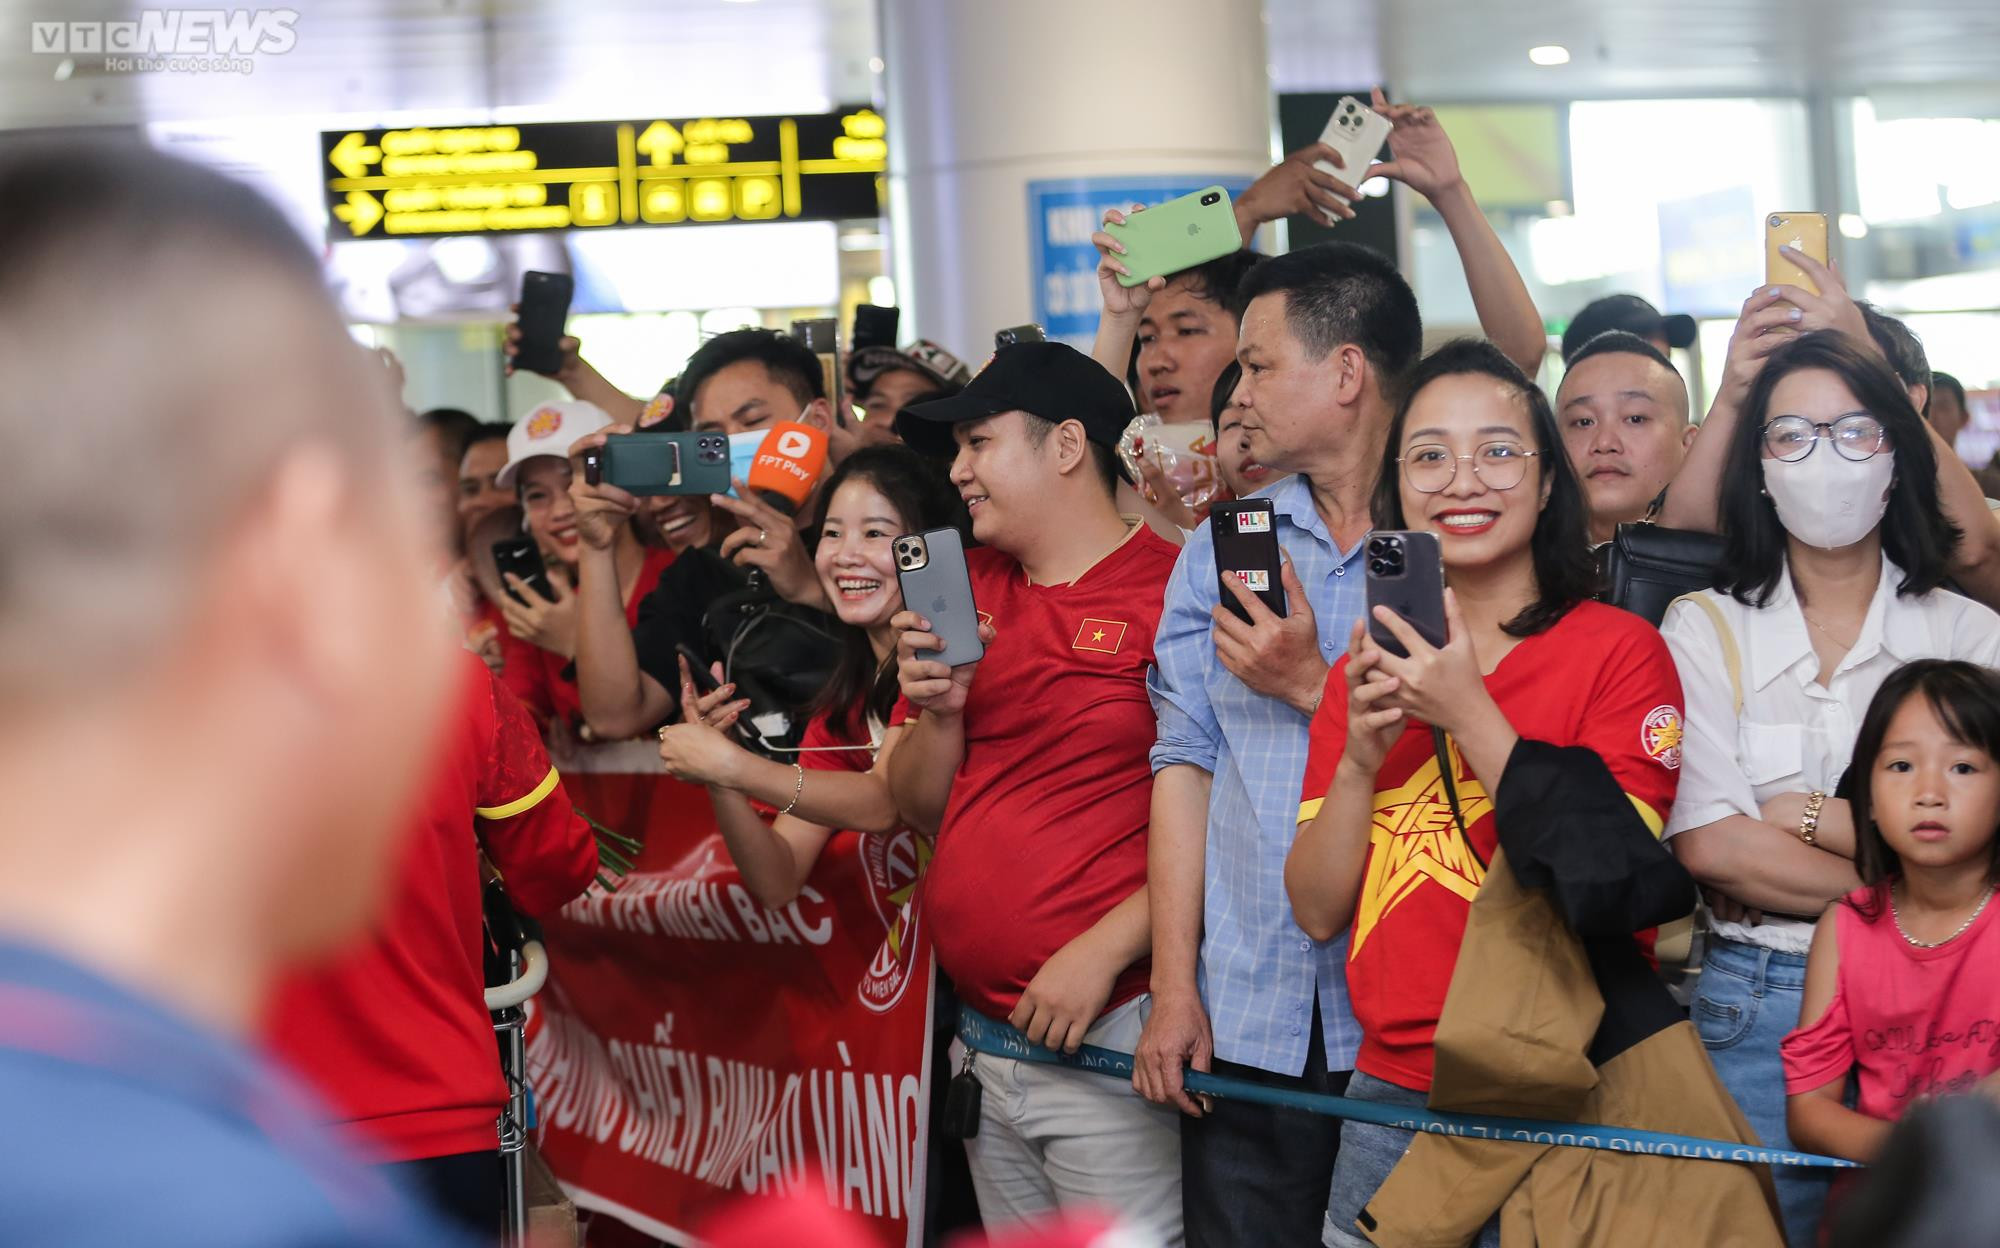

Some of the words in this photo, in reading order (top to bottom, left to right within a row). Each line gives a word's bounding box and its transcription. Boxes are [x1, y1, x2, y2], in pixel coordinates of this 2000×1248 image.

[758, 454, 783, 468] FPT
[781, 459, 811, 481] Play
[1239, 512, 1267, 526] HLX
[1237, 571, 1265, 584] HLX
